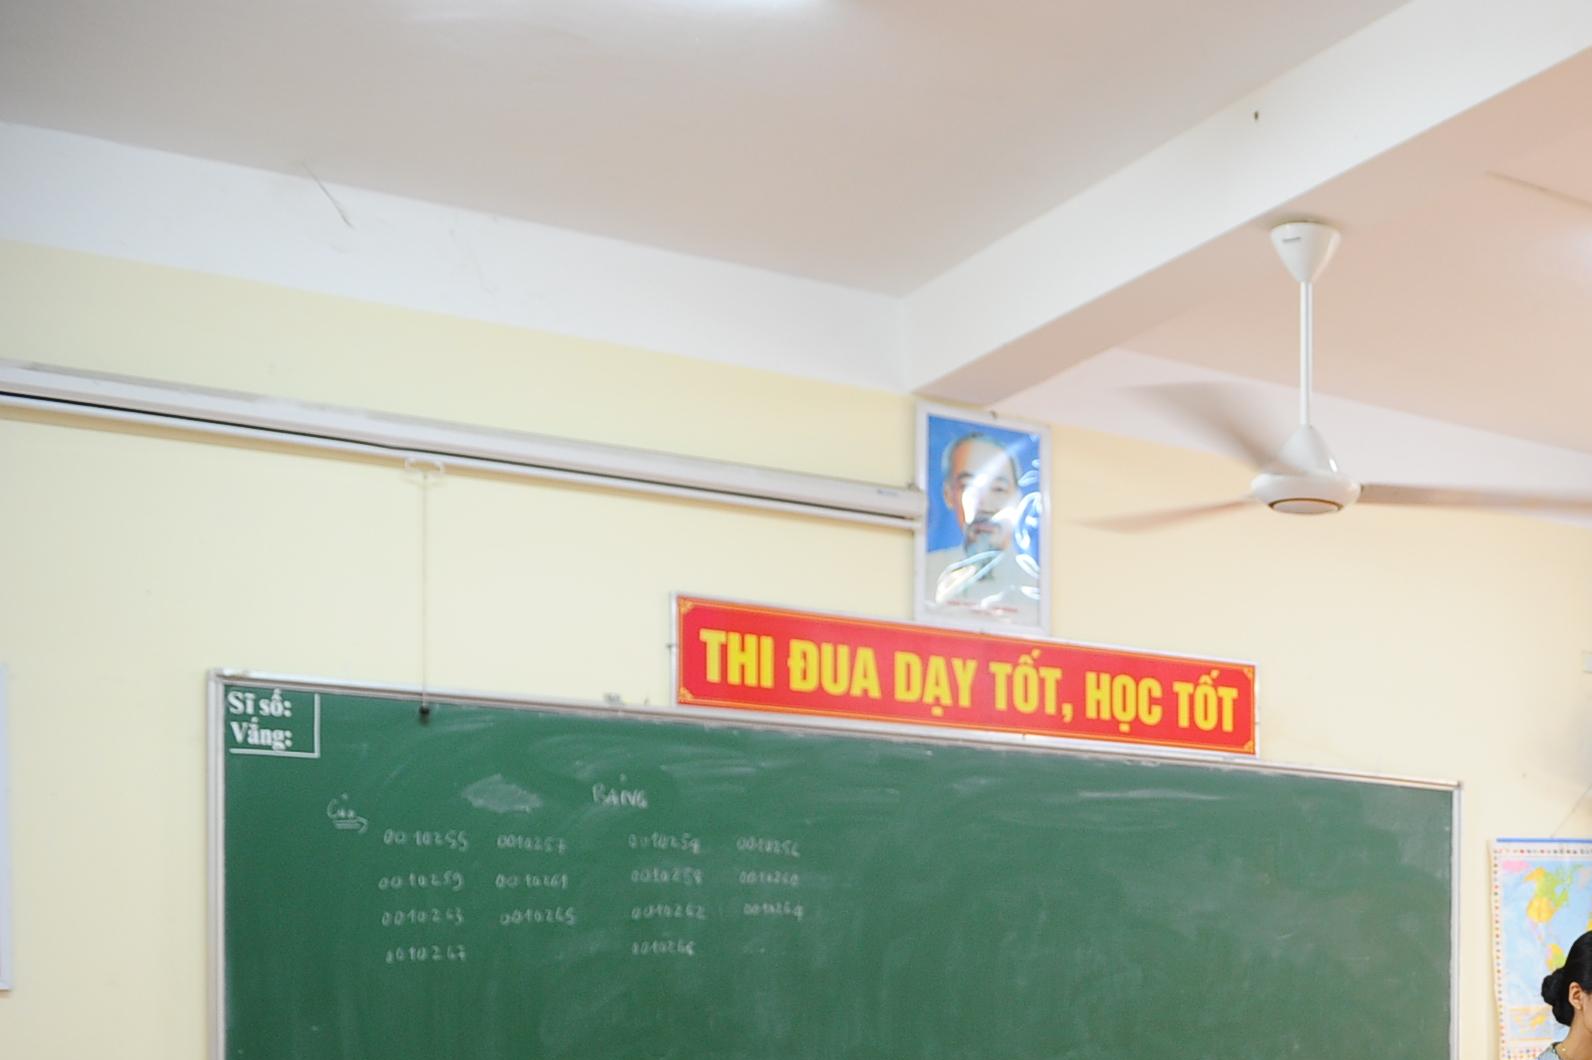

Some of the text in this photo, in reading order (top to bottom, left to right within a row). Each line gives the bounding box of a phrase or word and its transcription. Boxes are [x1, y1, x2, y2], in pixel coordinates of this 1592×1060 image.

[259, 688, 292, 718] số:
[699, 628, 1239, 733] THI ĐUA DẠY TỐT, HỌC TỐT
